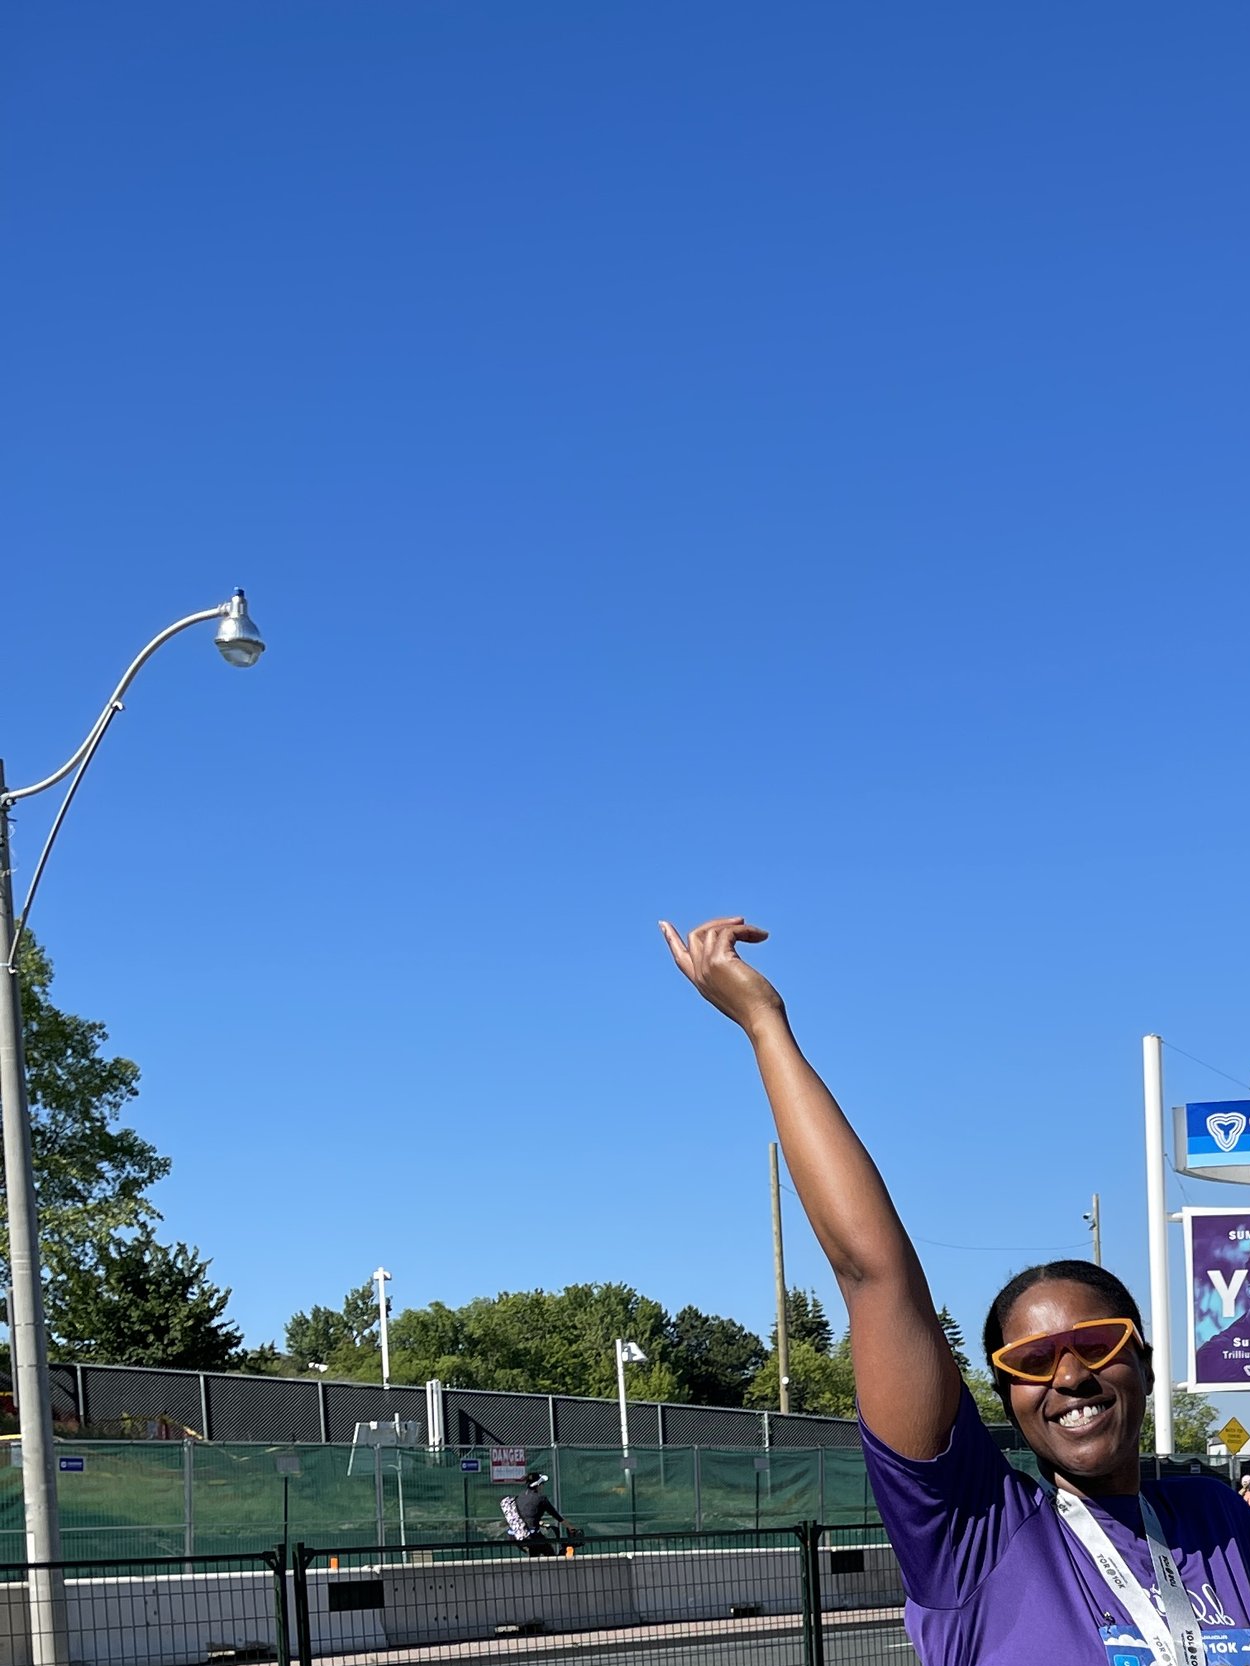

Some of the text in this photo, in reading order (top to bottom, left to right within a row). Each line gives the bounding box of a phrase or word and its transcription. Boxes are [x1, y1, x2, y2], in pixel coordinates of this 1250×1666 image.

[492, 1449, 525, 1462] DANGER
[1190, 1583, 1235, 1626] lub
[1208, 1642, 1239, 1654] 10K
